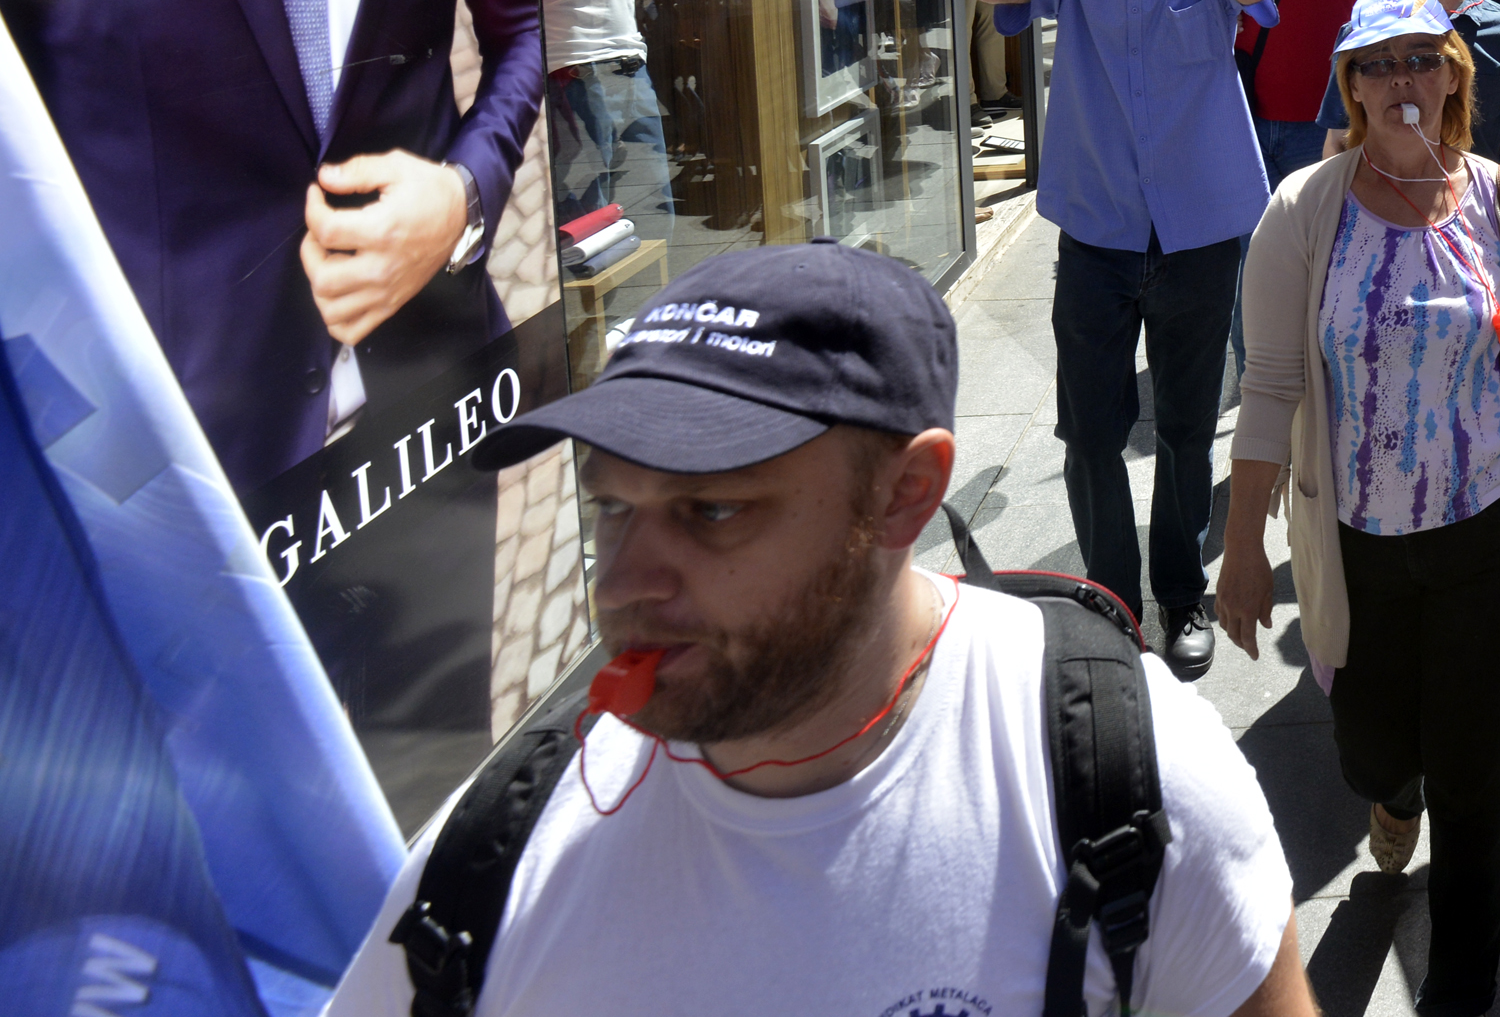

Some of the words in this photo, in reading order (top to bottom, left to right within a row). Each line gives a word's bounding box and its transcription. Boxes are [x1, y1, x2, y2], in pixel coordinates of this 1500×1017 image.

[644, 300, 760, 328] KONČAR
[706, 331, 777, 358] motori
[259, 368, 521, 588] GALILEO
[929, 987, 993, 1017] METALACA
